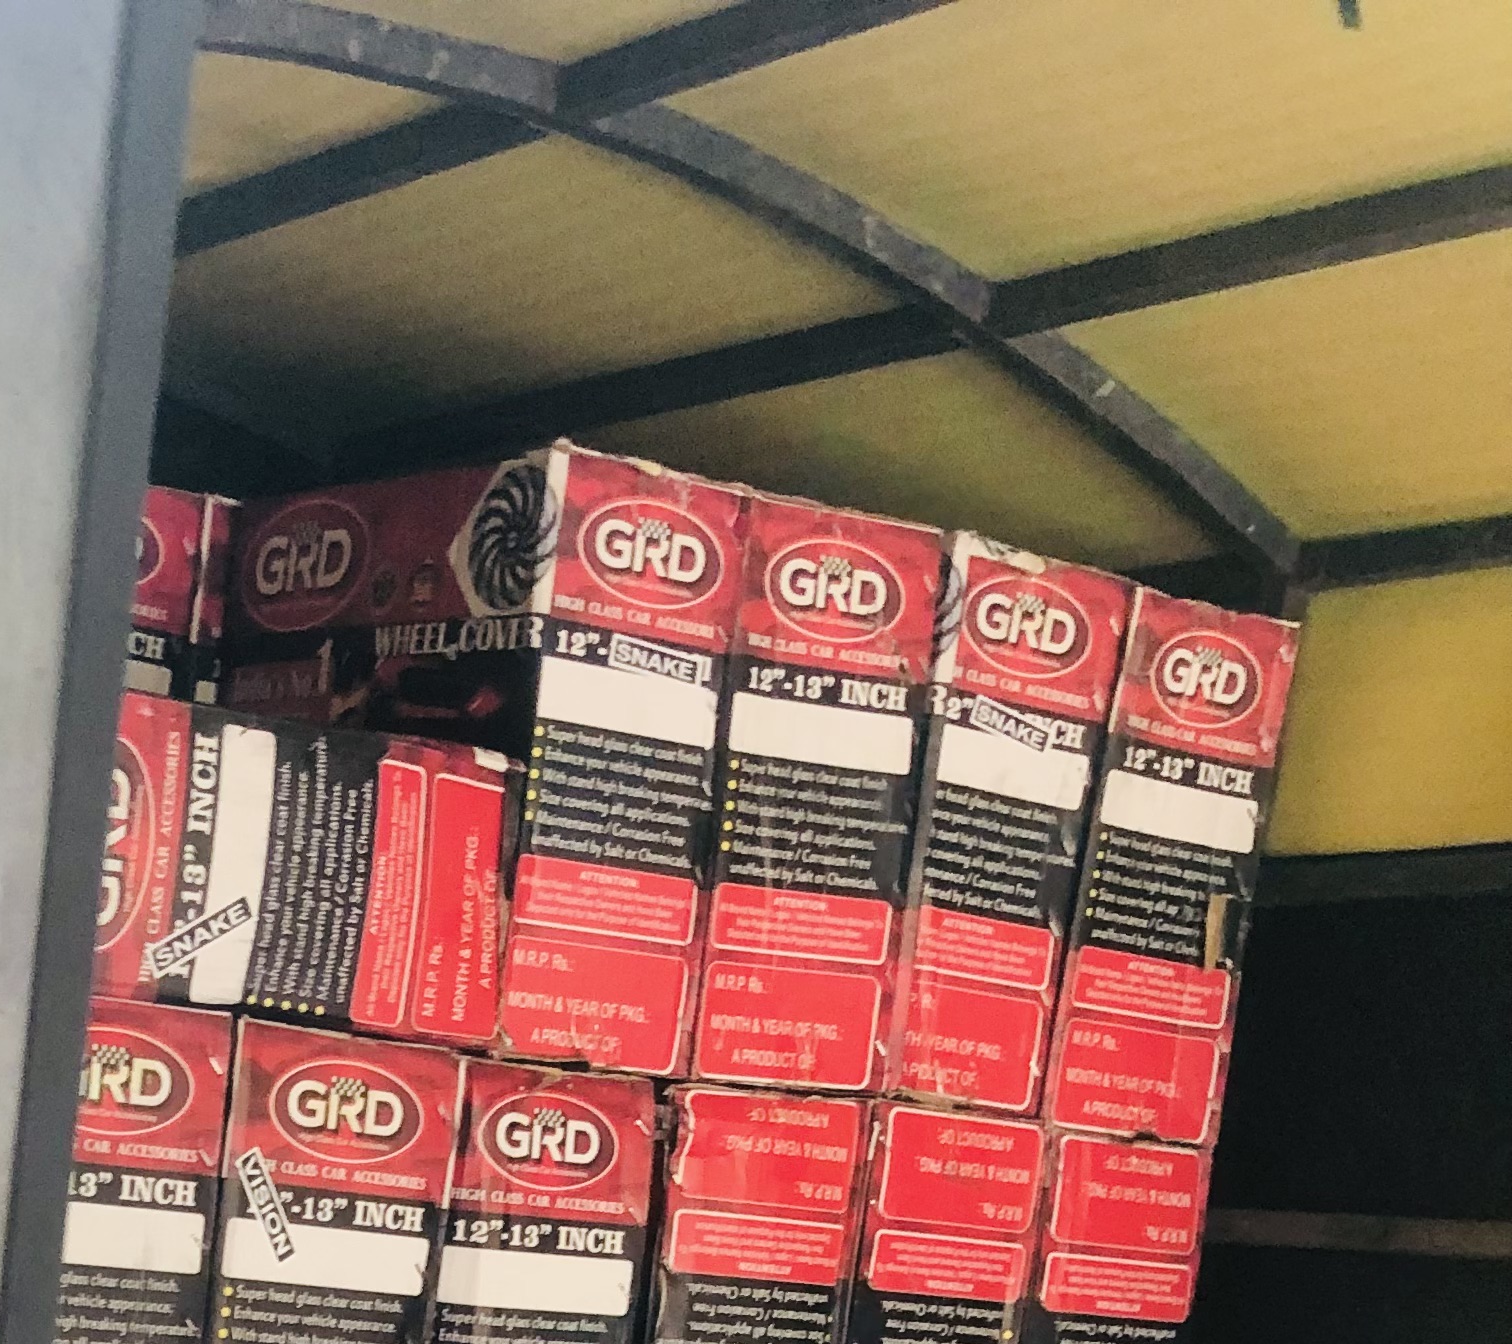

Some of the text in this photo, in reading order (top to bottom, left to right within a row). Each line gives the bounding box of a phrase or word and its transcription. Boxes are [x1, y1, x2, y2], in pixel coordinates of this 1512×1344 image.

[256, 521, 351, 595] GRD
[595, 518, 707, 584] GRD
[780, 556, 886, 616] GRD
[977, 592, 1077, 655] GRD
[615, 643, 696, 680] SNAKE
[1163, 646, 1247, 705] GRD
[841, 676, 906, 711] INCH
[975, 705, 1045, 748] SNAKE
[188, 732, 219, 835] INCH
[1198, 761, 1254, 794] INCH
[154, 846, 170, 879] CAR
[464, 872, 479, 896] OF
[155, 903, 250, 967] SNAKE
[459, 902, 479, 944] YEAR
[450, 972, 471, 1021] MONTH
[86, 1044, 173, 1107] RD
[288, 1076, 405, 1136] GRD
[495, 1108, 600, 1165] GRD
[120, 1175, 198, 1206] INCH
[323, 1165, 346, 1181] CAR
[245, 1155, 292, 1258] VISION
[353, 1200, 425, 1233] INCH
[528, 1194, 551, 1209] CAR
[557, 1226, 625, 1255] INCH
